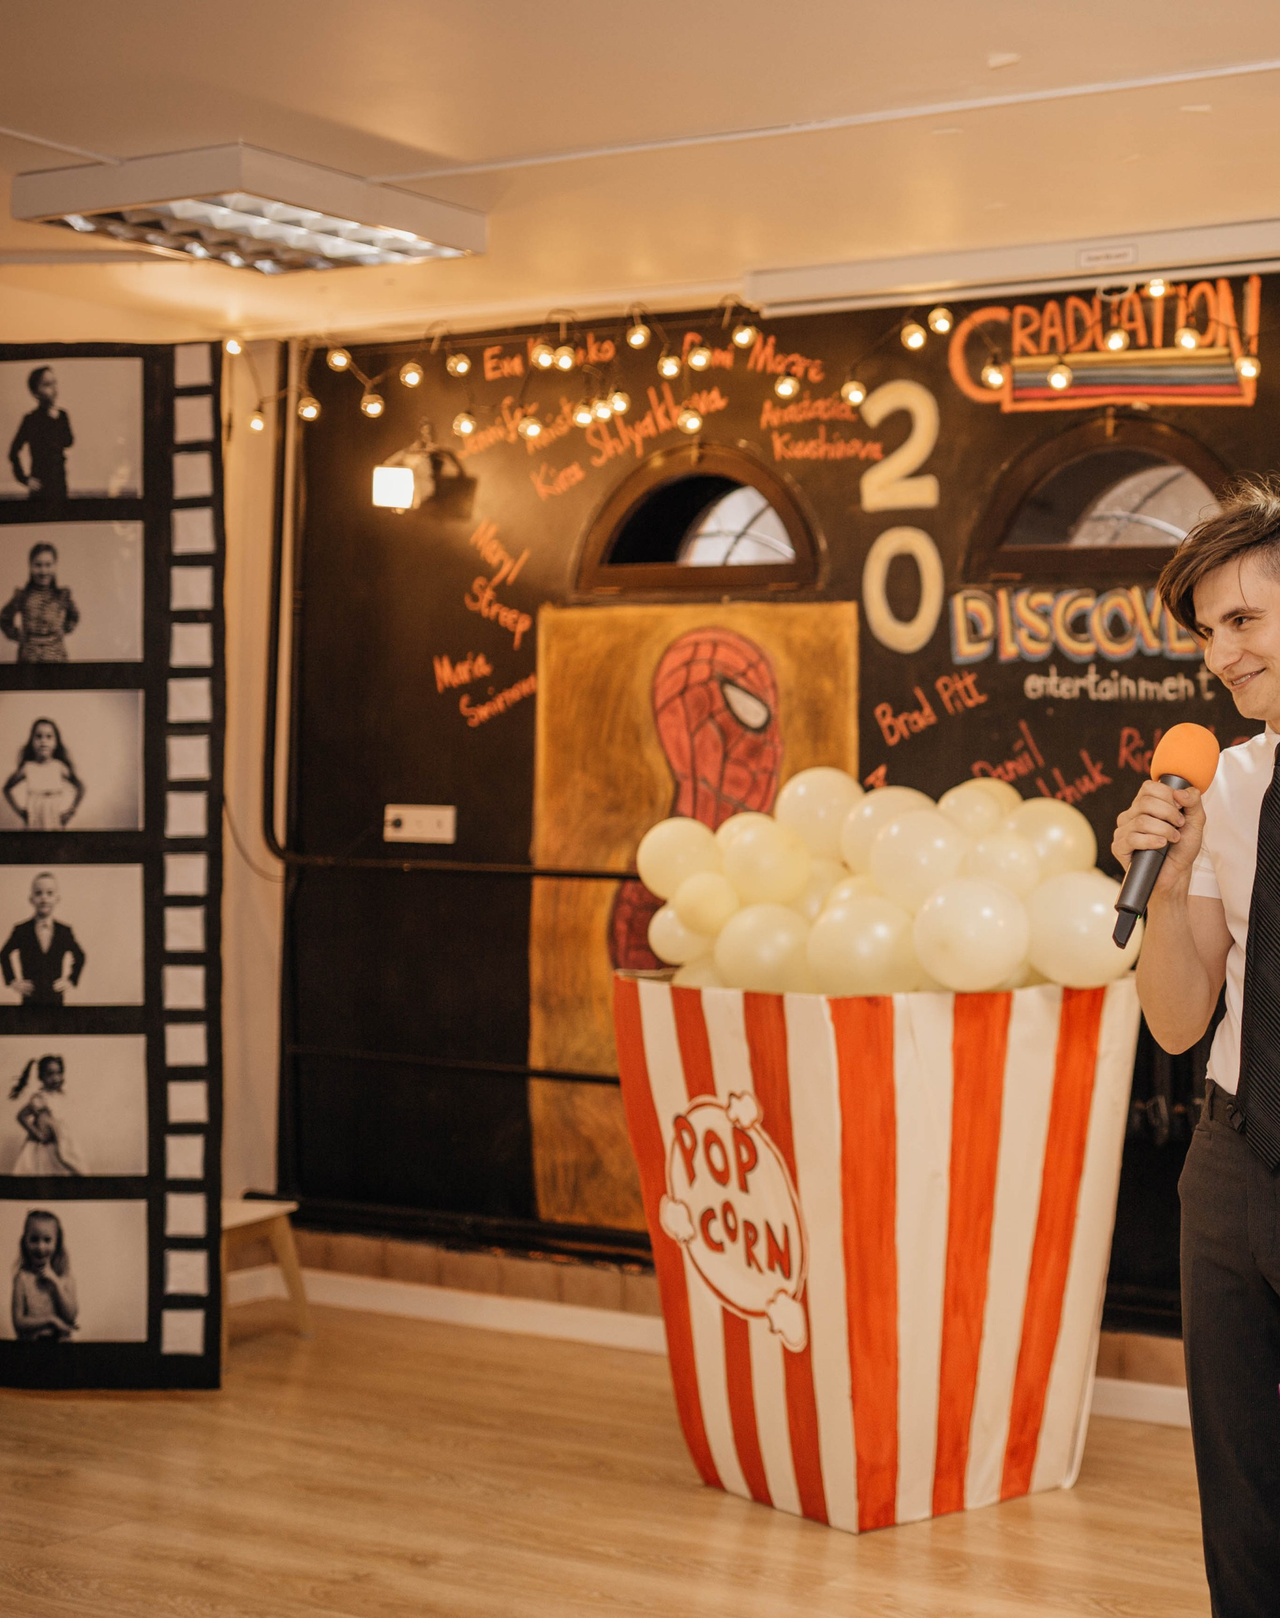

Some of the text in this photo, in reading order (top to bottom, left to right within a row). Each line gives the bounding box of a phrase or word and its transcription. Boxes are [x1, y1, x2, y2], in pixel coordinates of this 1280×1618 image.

[874, 670, 988, 746] Brad Pitt
[674, 1114, 758, 1193] POP
[699, 1201, 791, 1280] CORN
